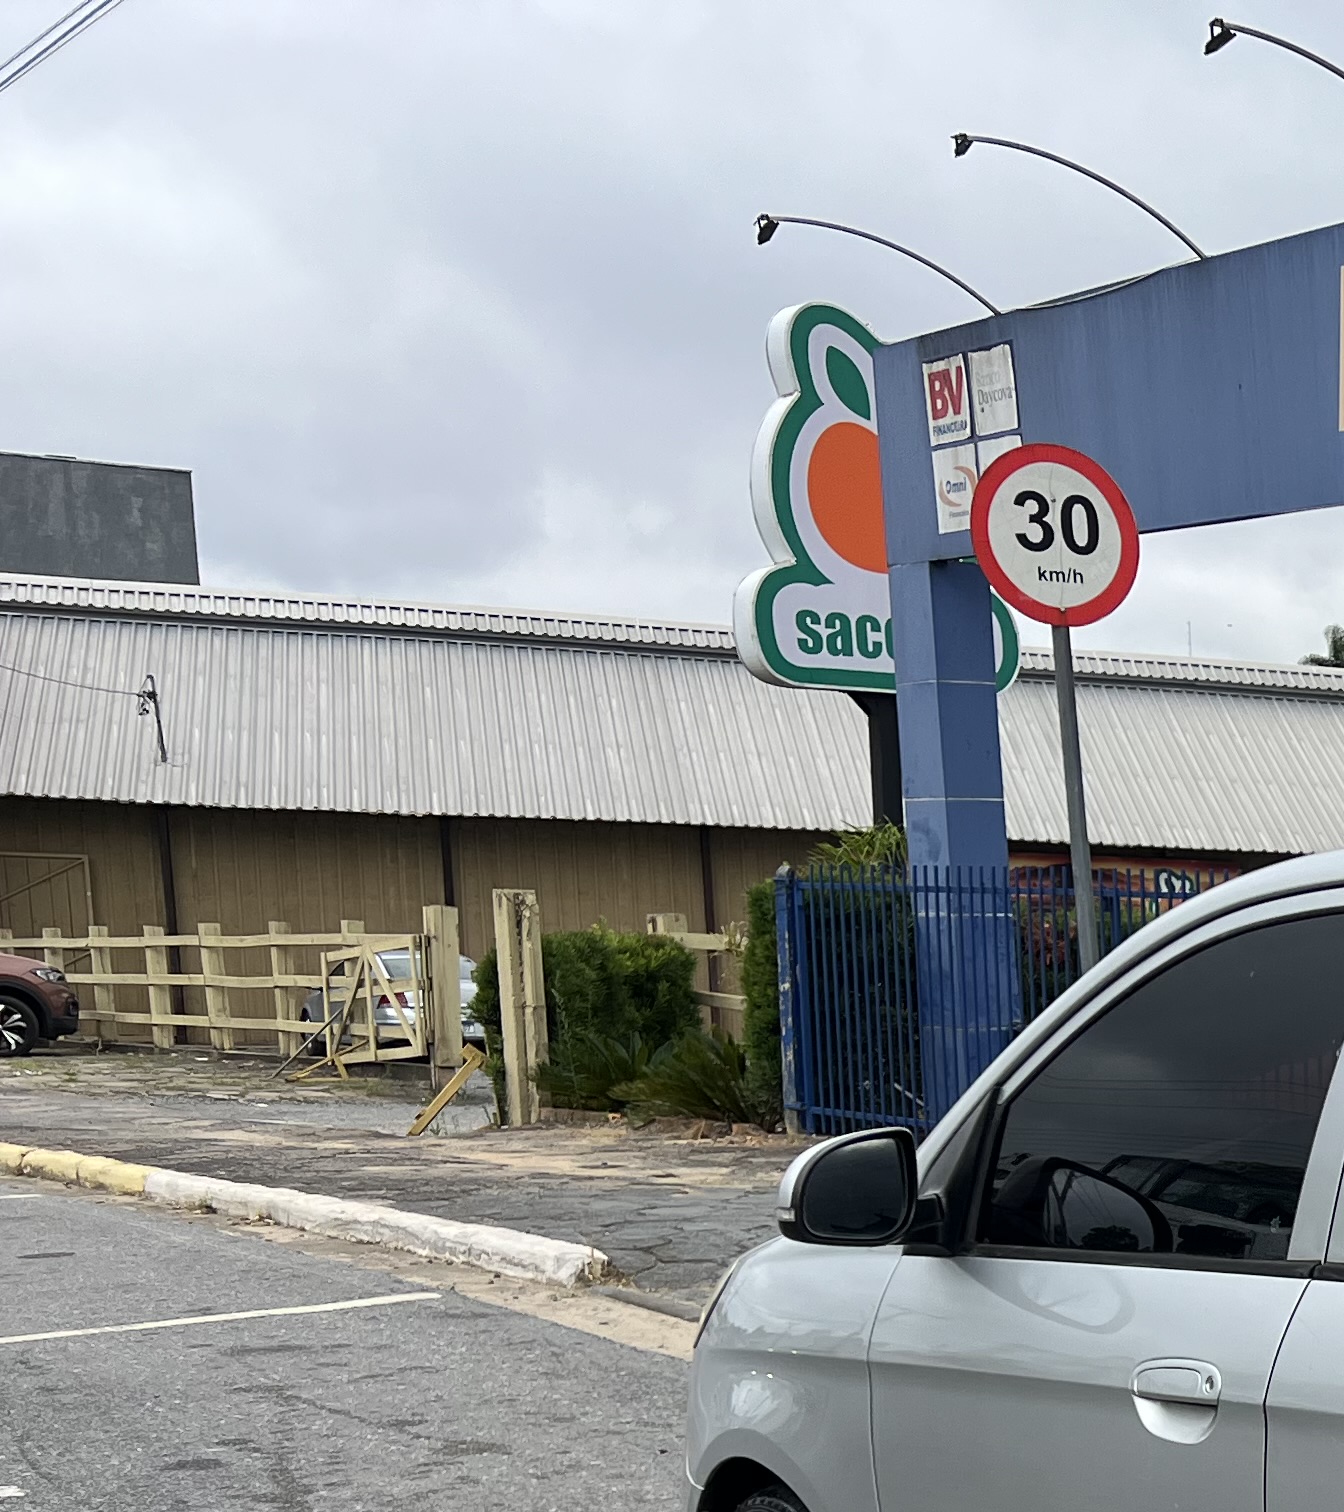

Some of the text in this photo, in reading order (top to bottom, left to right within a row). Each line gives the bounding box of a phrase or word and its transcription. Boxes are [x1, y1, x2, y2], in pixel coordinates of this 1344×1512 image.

[927, 365, 964, 420] BV
[945, 477, 967, 495] Omni
[1013, 490, 1100, 556] 30
[1037, 566, 1084, 585] km/h
